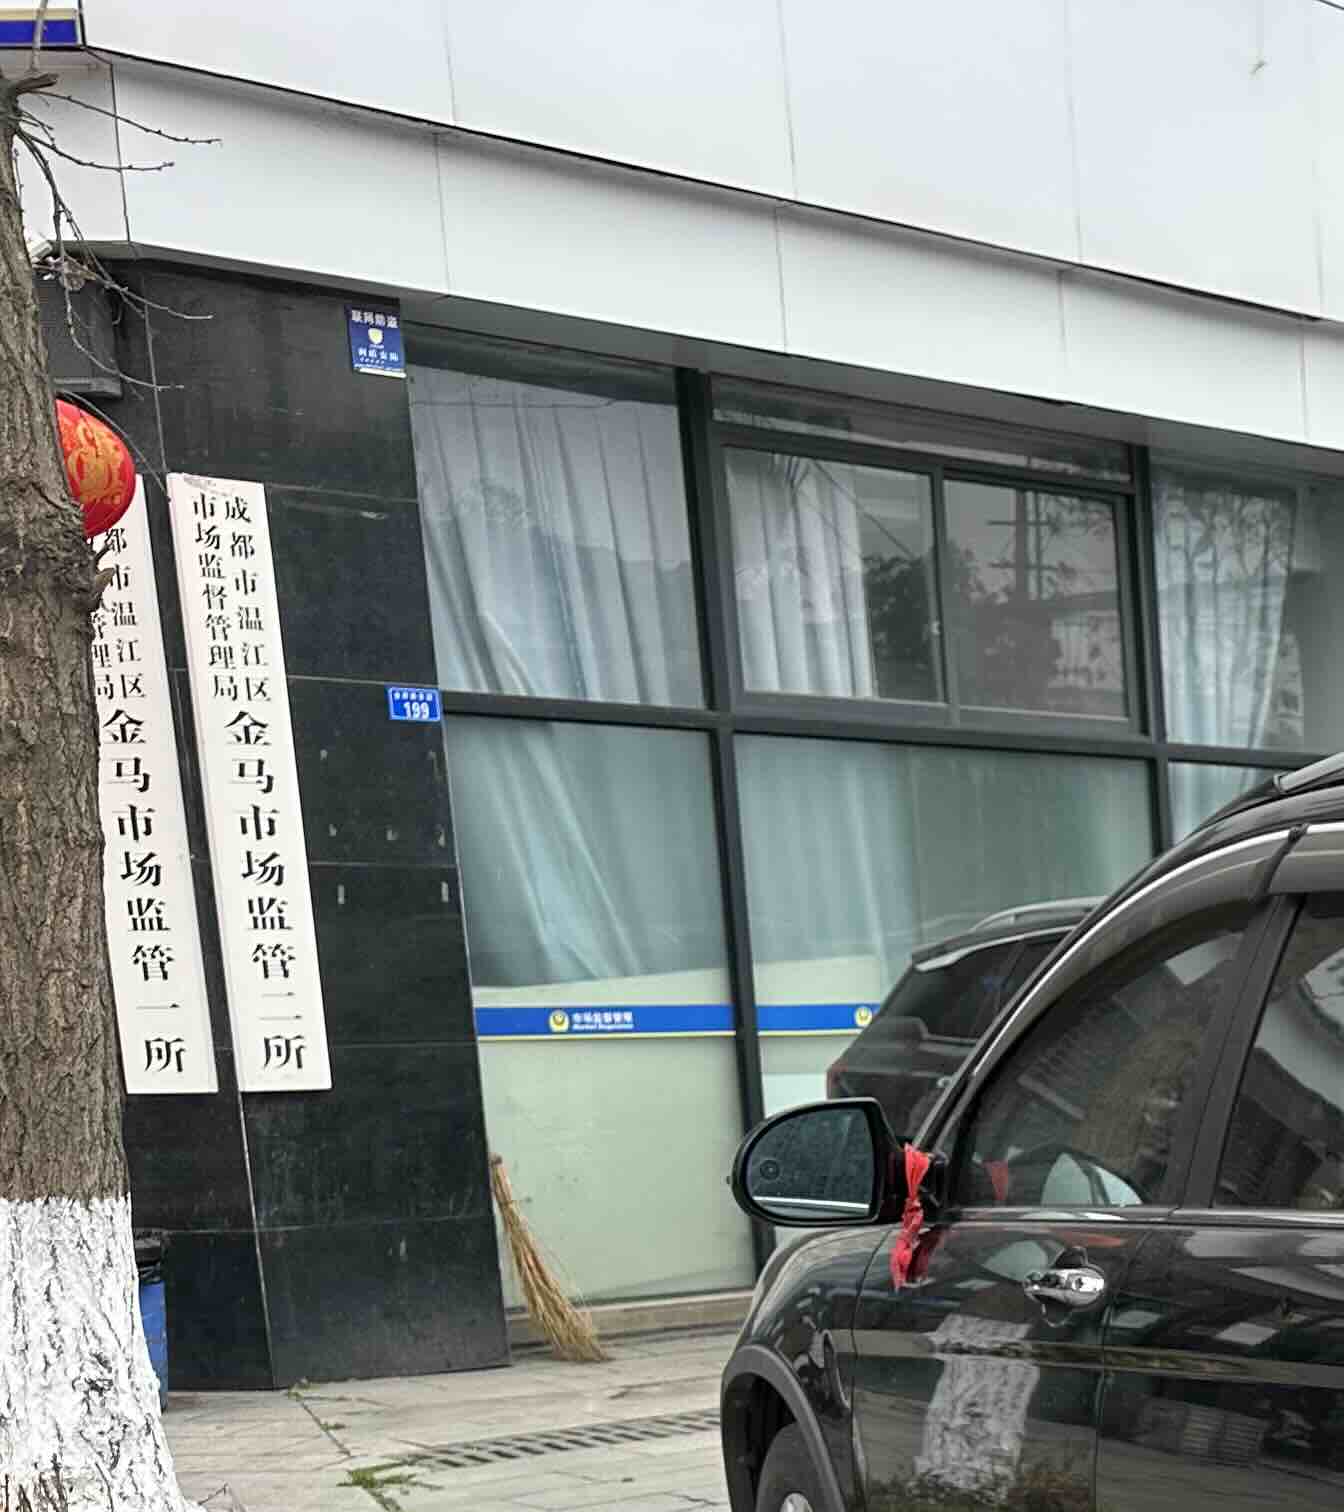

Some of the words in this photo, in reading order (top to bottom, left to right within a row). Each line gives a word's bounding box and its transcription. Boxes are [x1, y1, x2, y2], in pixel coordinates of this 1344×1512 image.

[224, 496, 271, 702] 成都市温江区
[403, 701, 430, 720] 199
[102, 708, 187, 1075] 金马市场监管一所
[224, 710, 307, 1071] 金马市场监管二所
